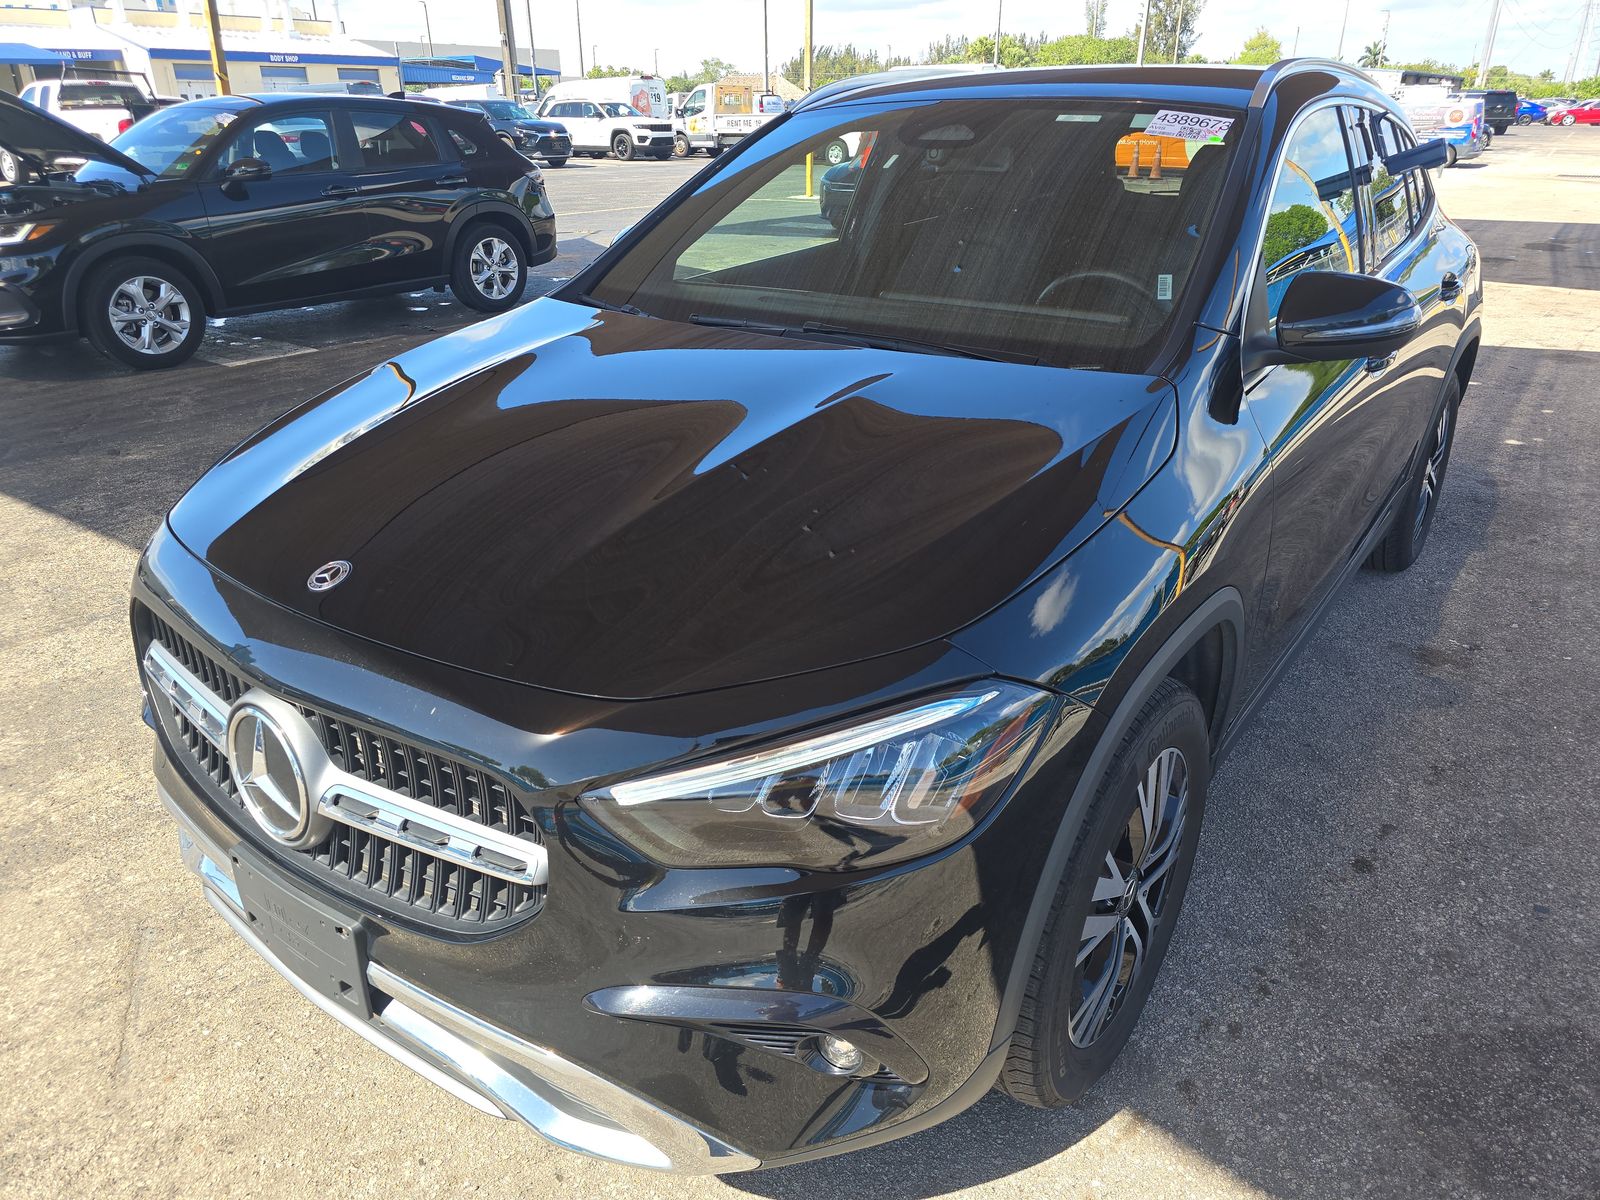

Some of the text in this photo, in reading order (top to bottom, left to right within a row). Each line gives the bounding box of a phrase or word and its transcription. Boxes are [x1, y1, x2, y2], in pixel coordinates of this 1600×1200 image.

[77, 51, 92, 59] BUFF
[269, 54, 284, 62] BODY
[726, 119, 741, 127] RENT
[743, 119, 752, 127] ME
[1157, 113, 1232, 131] 4389673
